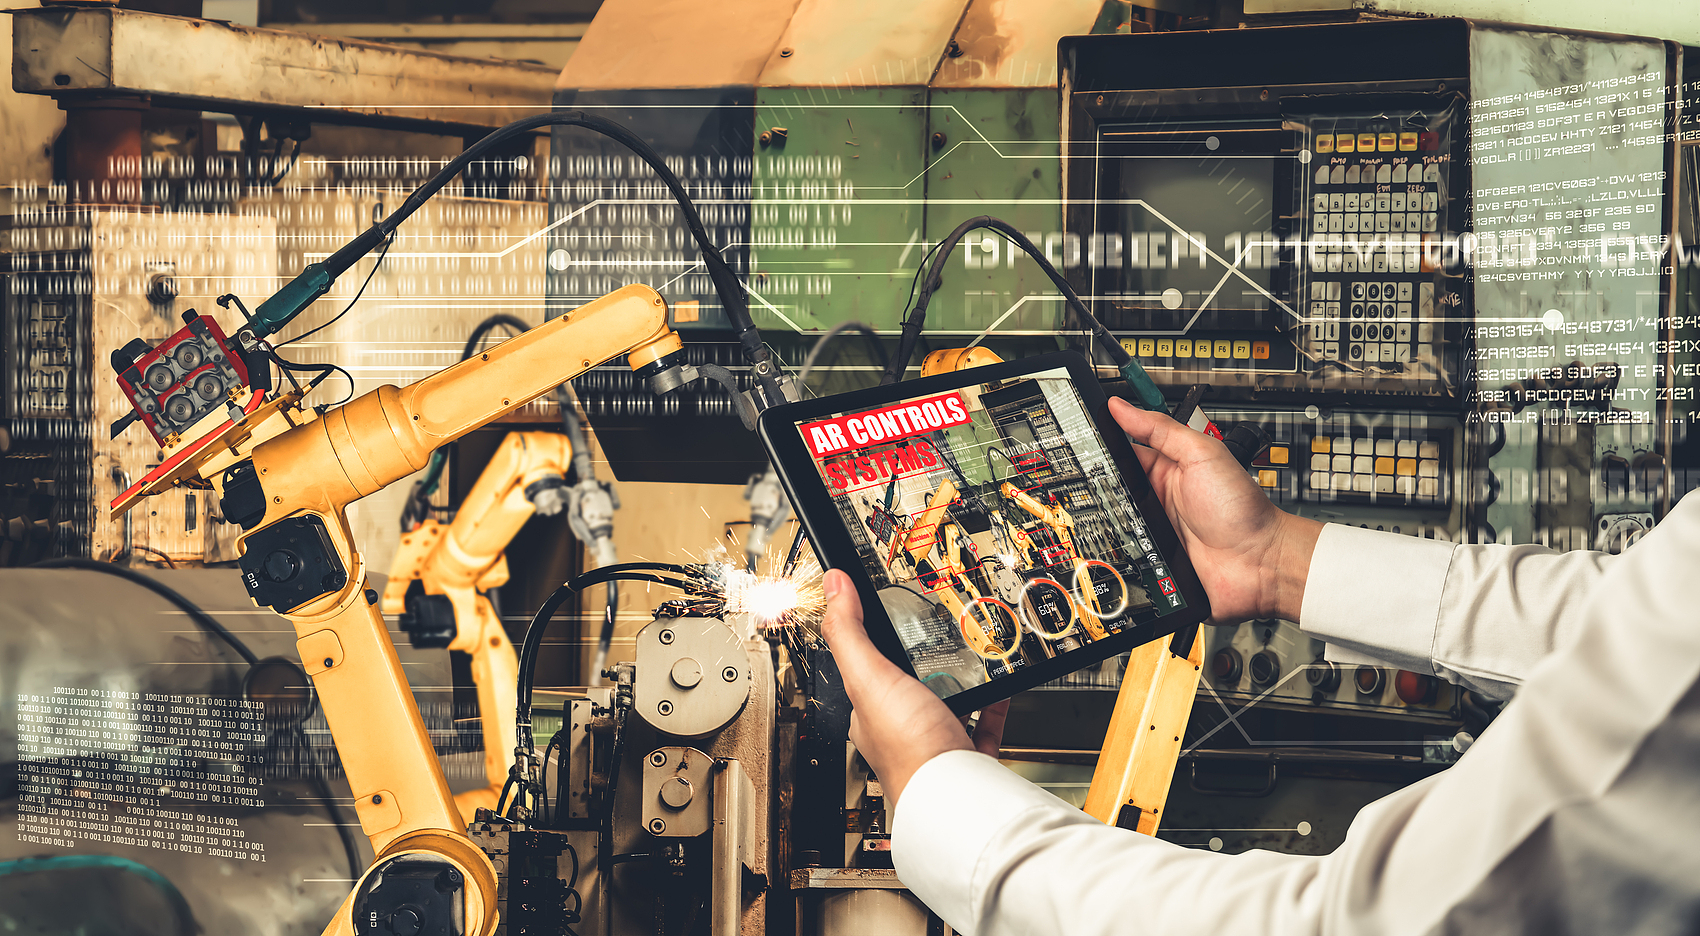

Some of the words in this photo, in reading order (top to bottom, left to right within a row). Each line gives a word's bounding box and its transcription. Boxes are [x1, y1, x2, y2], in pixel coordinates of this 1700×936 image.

[810, 423, 849, 454] AR
[847, 397, 966, 445] CONTROLS
[825, 442, 937, 490] SYSTEMS
